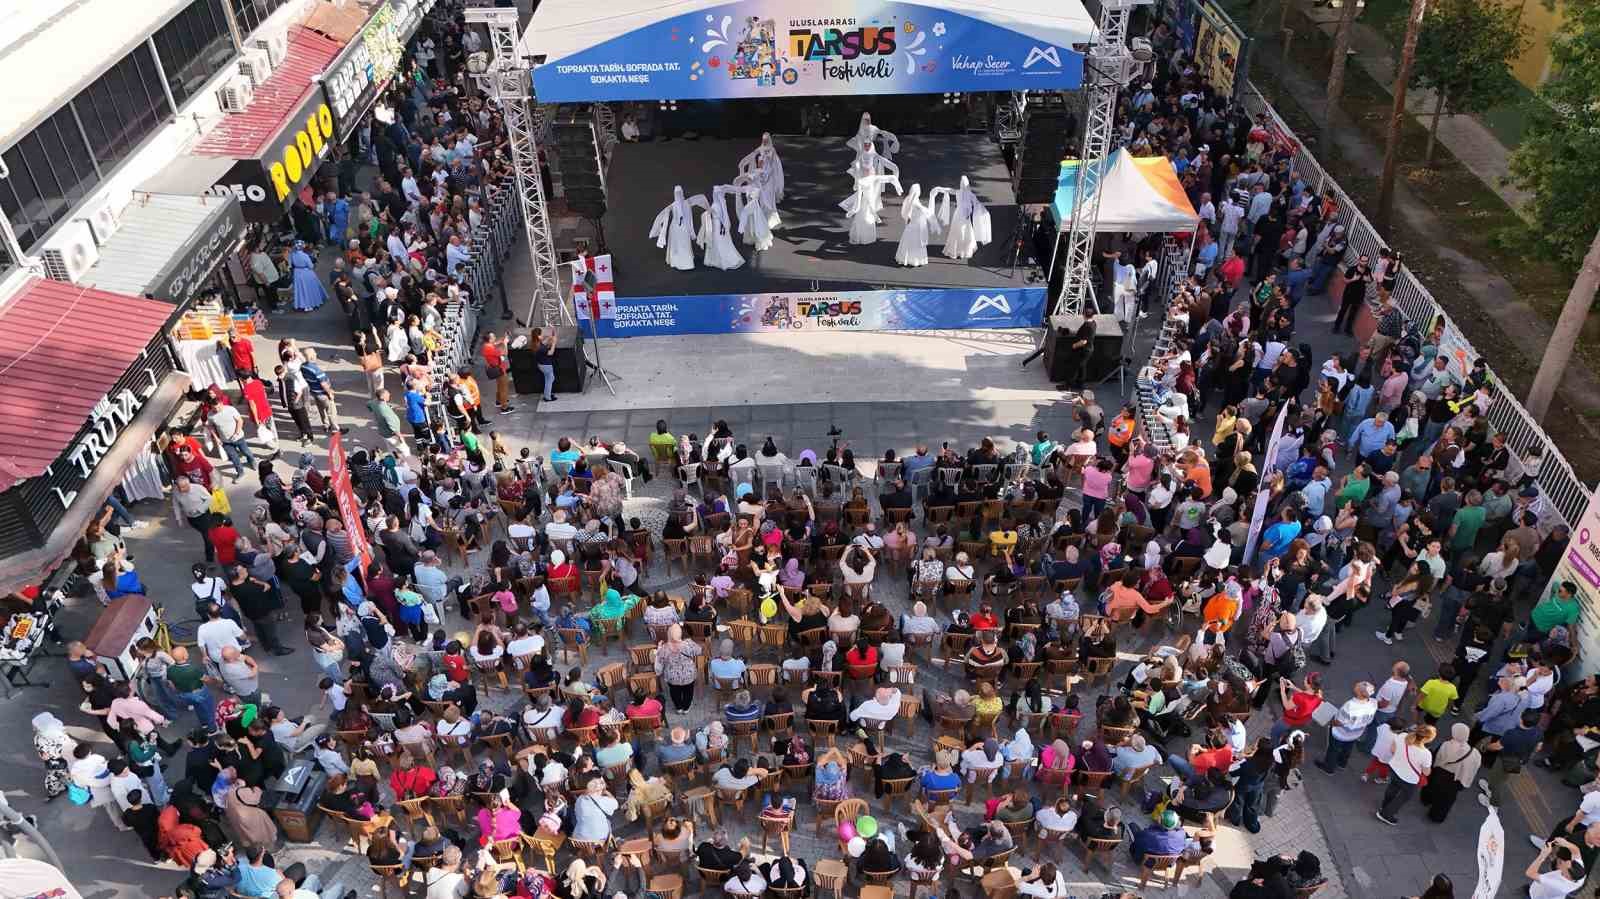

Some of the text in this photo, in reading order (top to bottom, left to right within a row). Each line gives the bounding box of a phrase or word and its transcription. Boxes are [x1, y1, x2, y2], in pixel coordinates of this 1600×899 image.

[789, 27, 896, 60] TARSUS
[557, 64, 599, 74] TOPRAKTA
[626, 62, 663, 72] SOFRADA
[821, 58, 894, 82] Festivali
[590, 74, 627, 84] SOKAKTA
[270, 103, 333, 203] RODEO
[615, 304, 651, 313] PRAKTA
[797, 301, 862, 317] TARSUS
[615, 312, 655, 321] SOFRADA
[613, 319, 653, 329] SOKAKTA
[67, 388, 143, 480] TRUVA
